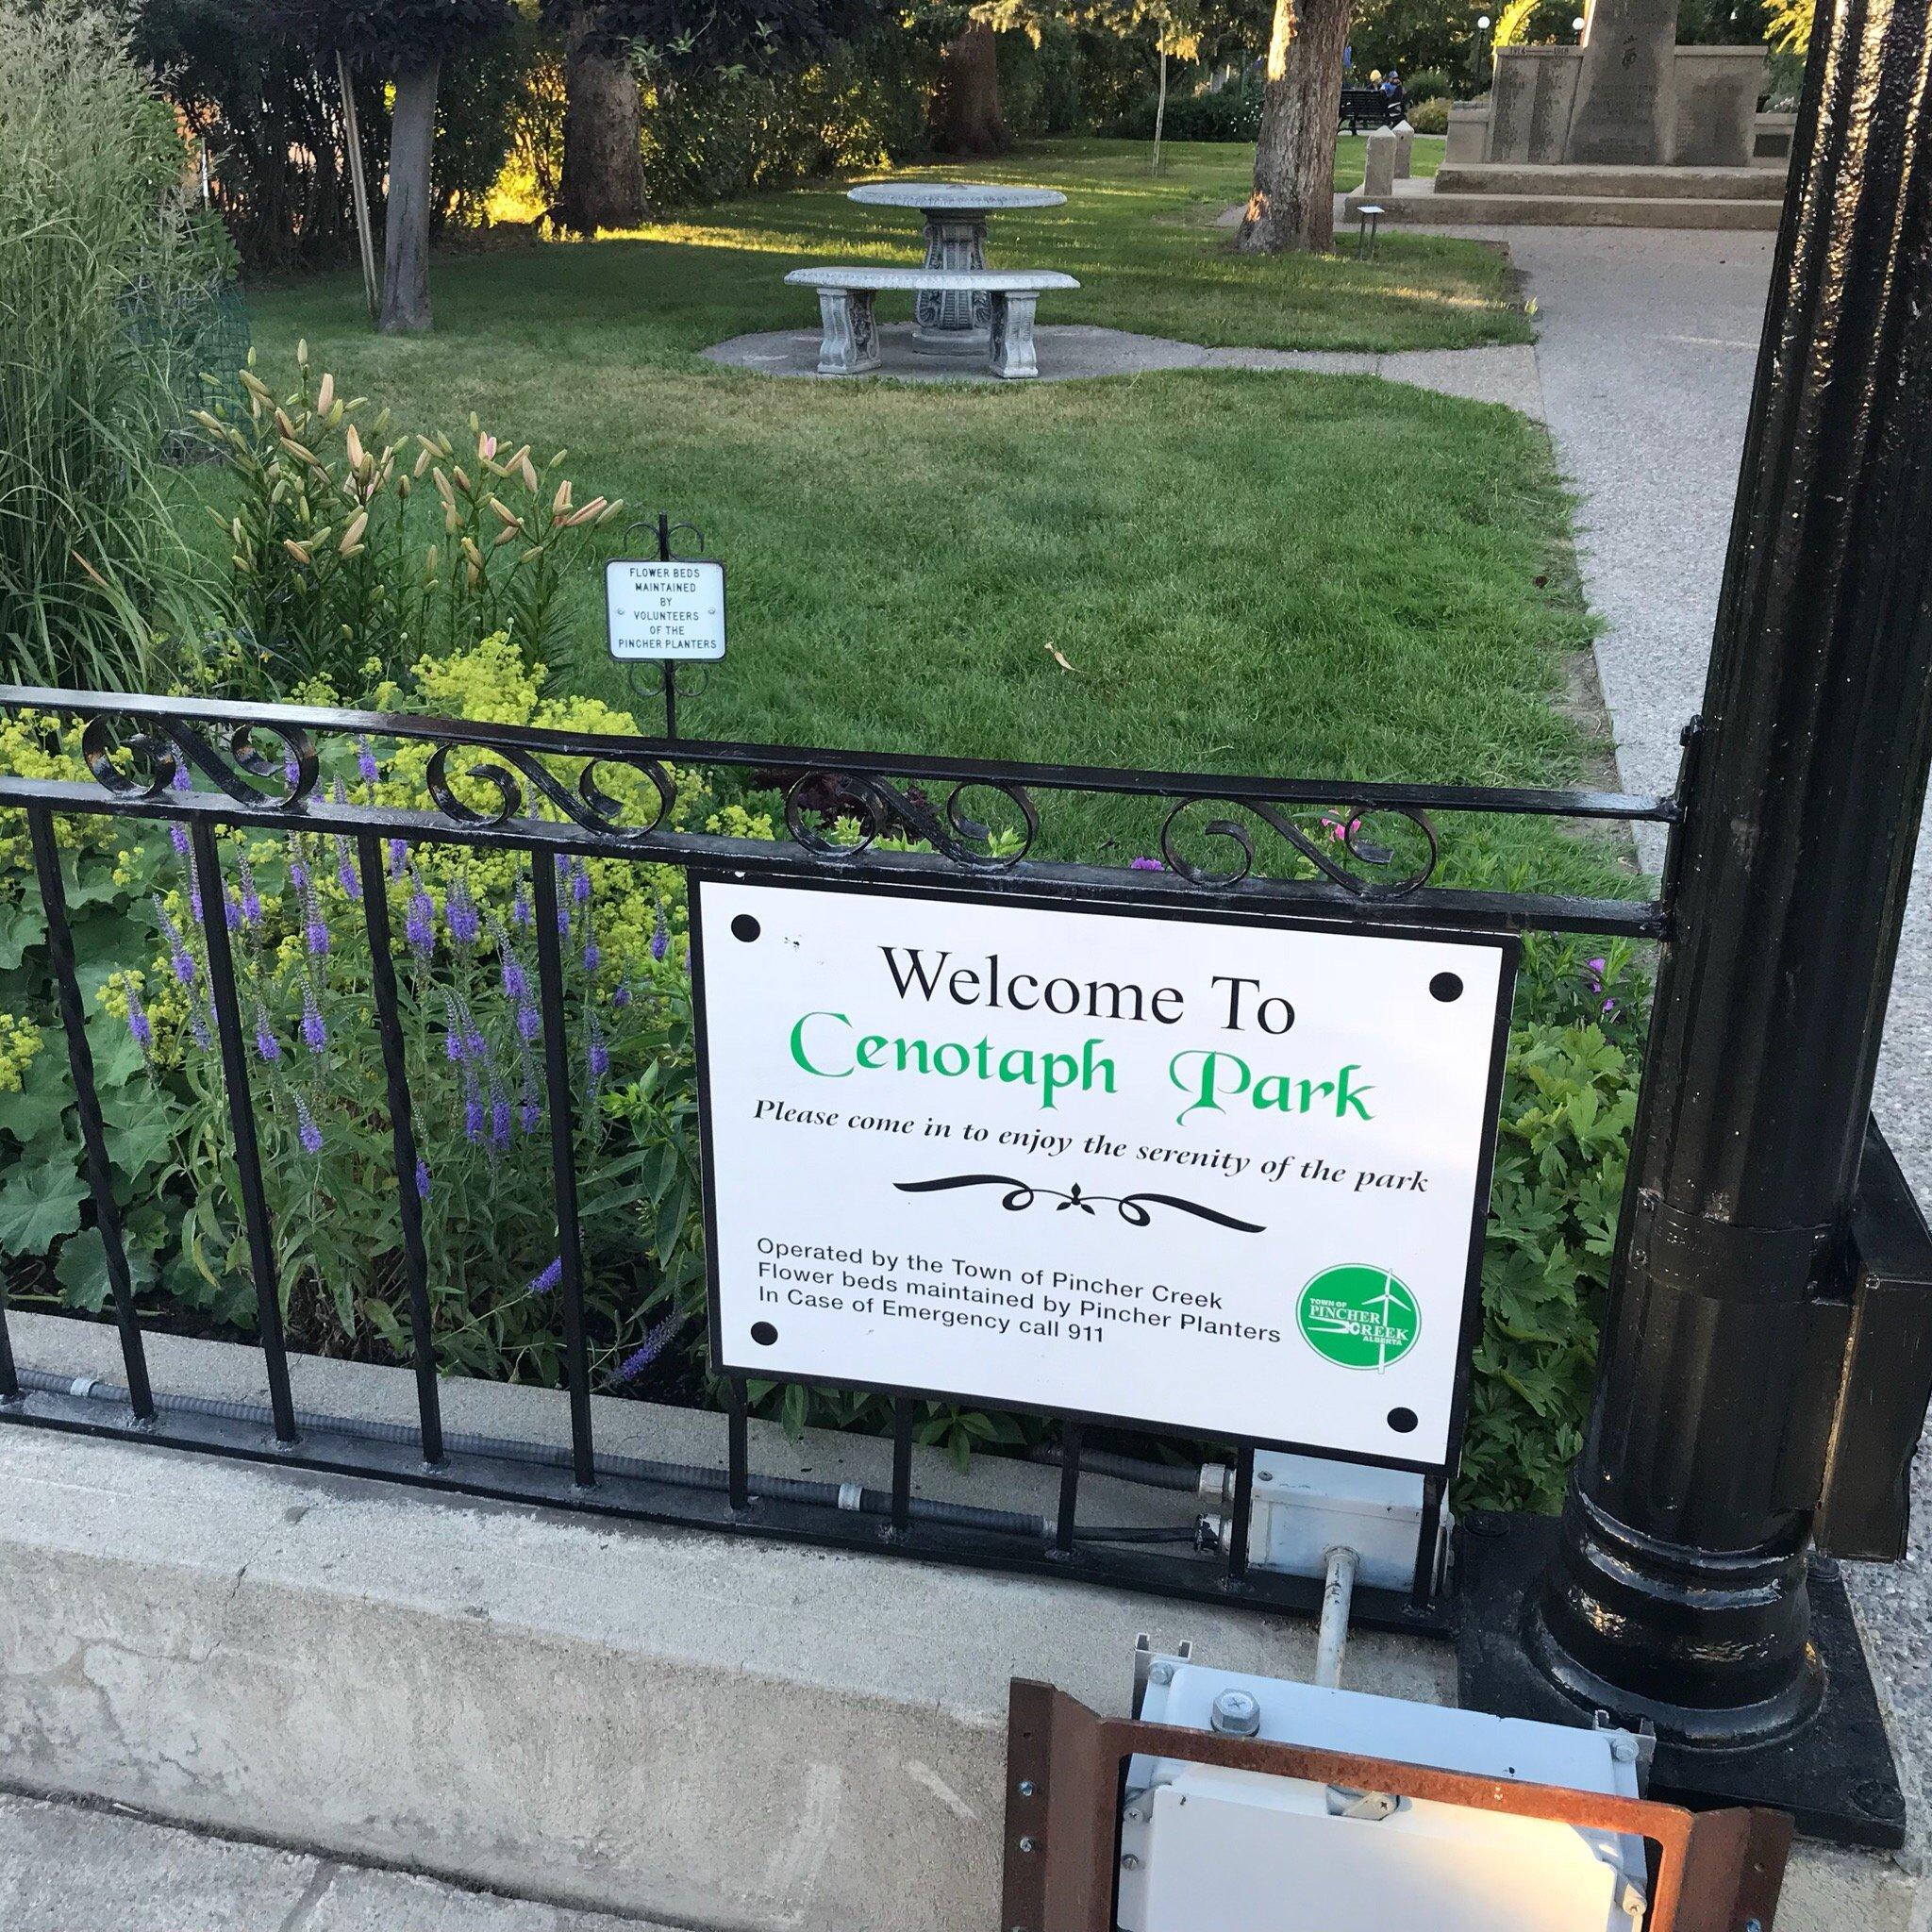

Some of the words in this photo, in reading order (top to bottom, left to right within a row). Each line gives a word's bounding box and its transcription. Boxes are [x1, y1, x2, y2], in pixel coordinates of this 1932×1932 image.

[629, 567, 670, 578] FLOWER
[673, 568, 700, 578] BEDS
[635, 582, 696, 592] MAINTAINED
[660, 597, 673, 607] BY
[633, 610, 699, 622] VOLUNTEERS
[649, 625, 662, 636] OF
[665, 625, 685, 636] THE
[618, 639, 662, 649] PINCHER
[665, 639, 717, 650] PLANTERS
[877, 945, 1184, 1024] Welcome
[1210, 975, 1296, 1036] To
[790, 1012, 1118, 1110] Cenotaph
[1169, 1050, 1375, 1126] Park
[754, 1099, 840, 1126] Please
[847, 1116, 915, 1135] come
[924, 1117, 952, 1139] in
[962, 1124, 990, 1142] to
[998, 1128, 1074, 1158] enjoy
[1083, 1134, 1128, 1158] the
[1136, 1145, 1252, 1178] serenity
[1259, 1156, 1295, 1183] of
[1300, 1159, 1347, 1184] the
[1353, 1171, 1429, 1193] park
[757, 1238, 863, 1264] Operated
[872, 1250, 899, 1272] by
[907, 1255, 944, 1274] the
[951, 1259, 1012, 1282] Town
[1021, 1270, 1044, 1286] of
[1053, 1272, 1145, 1299] Pincher
[1152, 1285, 1224, 1309] Creek
[758, 1262, 835, 1286] Flower
[842, 1271, 899, 1292] beds
[907, 1281, 1035, 1309] maintained
[1043, 1295, 1072, 1318] by
[1080, 1300, 1173, 1328] Pincher
[1180, 1313, 1282, 1342] Planters
[759, 1286, 779, 1303] In
[787, 1289, 844, 1310] Case
[852, 1298, 874, 1313] of
[883, 1299, 1011, 1334] Emergency
[1019, 1320, 1059, 1338] call
[1068, 1324, 1104, 1342] 911
[1309, 1305, 1380, 1324] PINCHER
[1350, 1322, 1409, 1341] CREEK
[1363, 1335, 1403, 1346] ALBERTA
